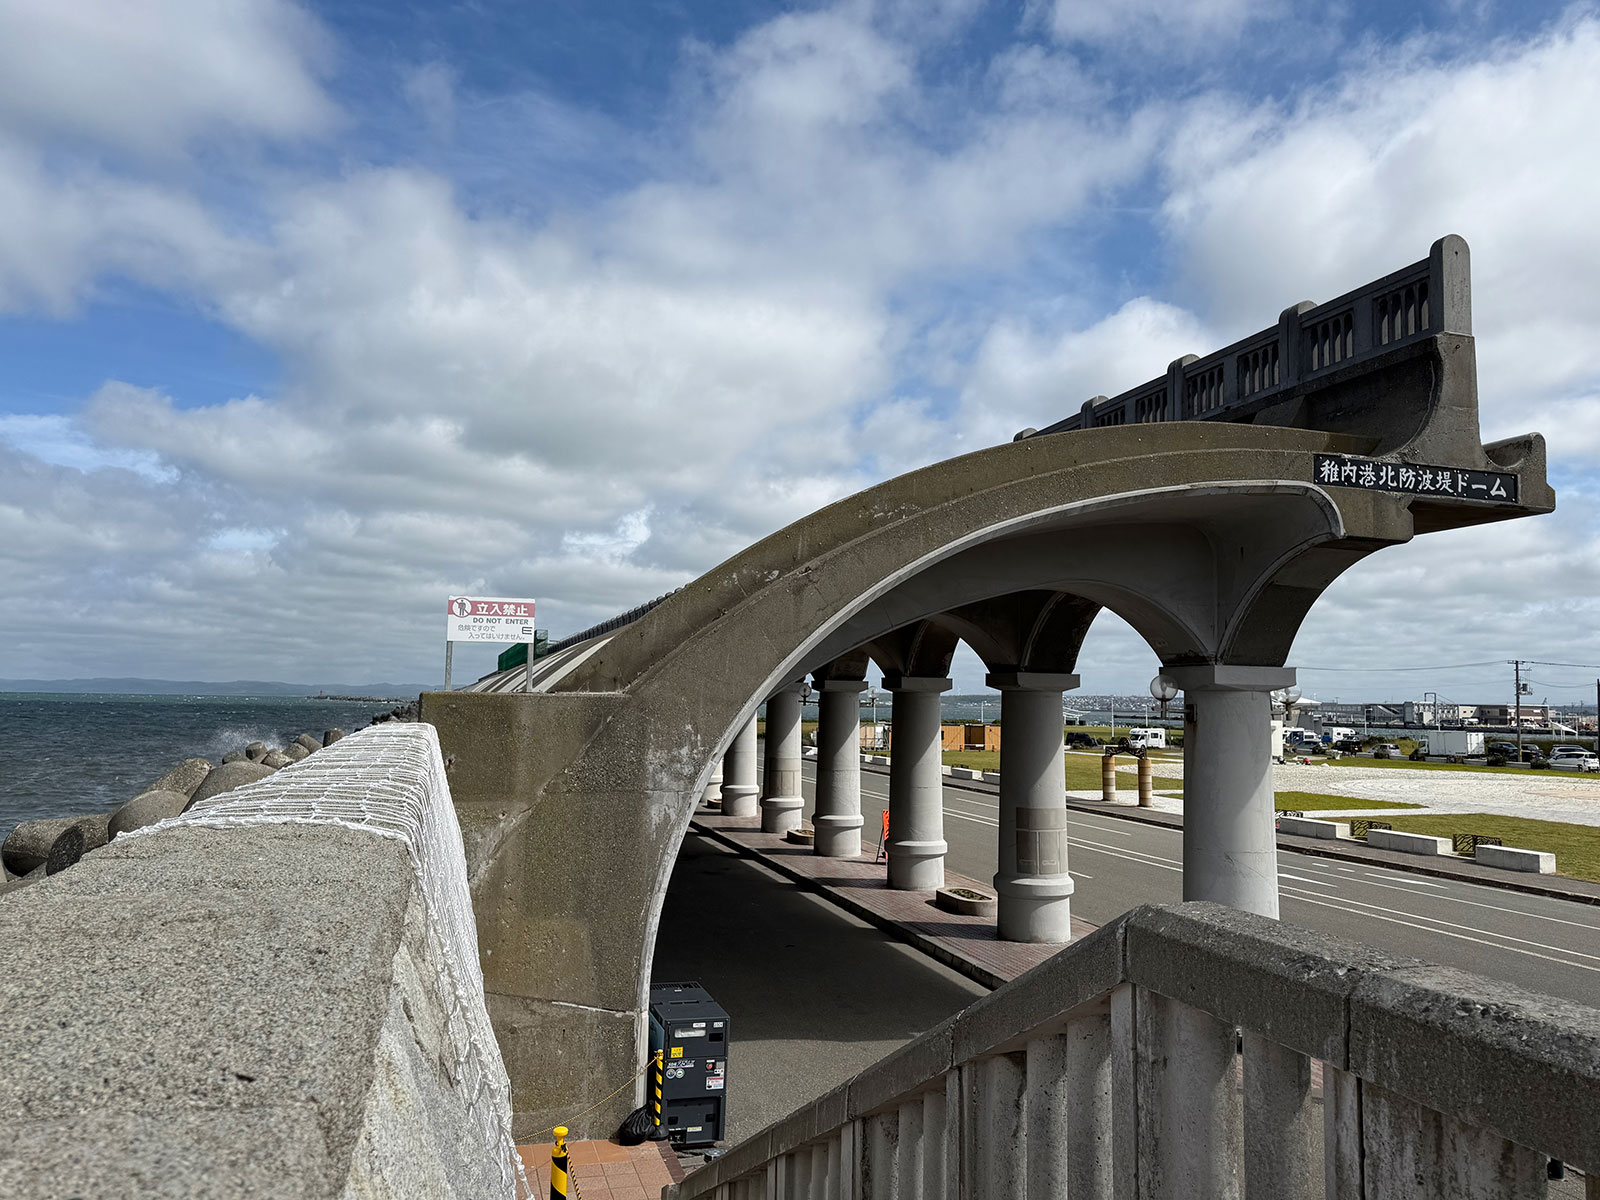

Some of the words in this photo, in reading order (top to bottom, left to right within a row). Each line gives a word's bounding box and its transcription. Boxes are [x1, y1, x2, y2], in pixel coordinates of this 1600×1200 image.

[1319, 459, 1507, 498] 稚内港北防波堤ドーム
[476, 602, 529, 616] 立入禁止
[458, 624, 496, 632] 危険ですので
